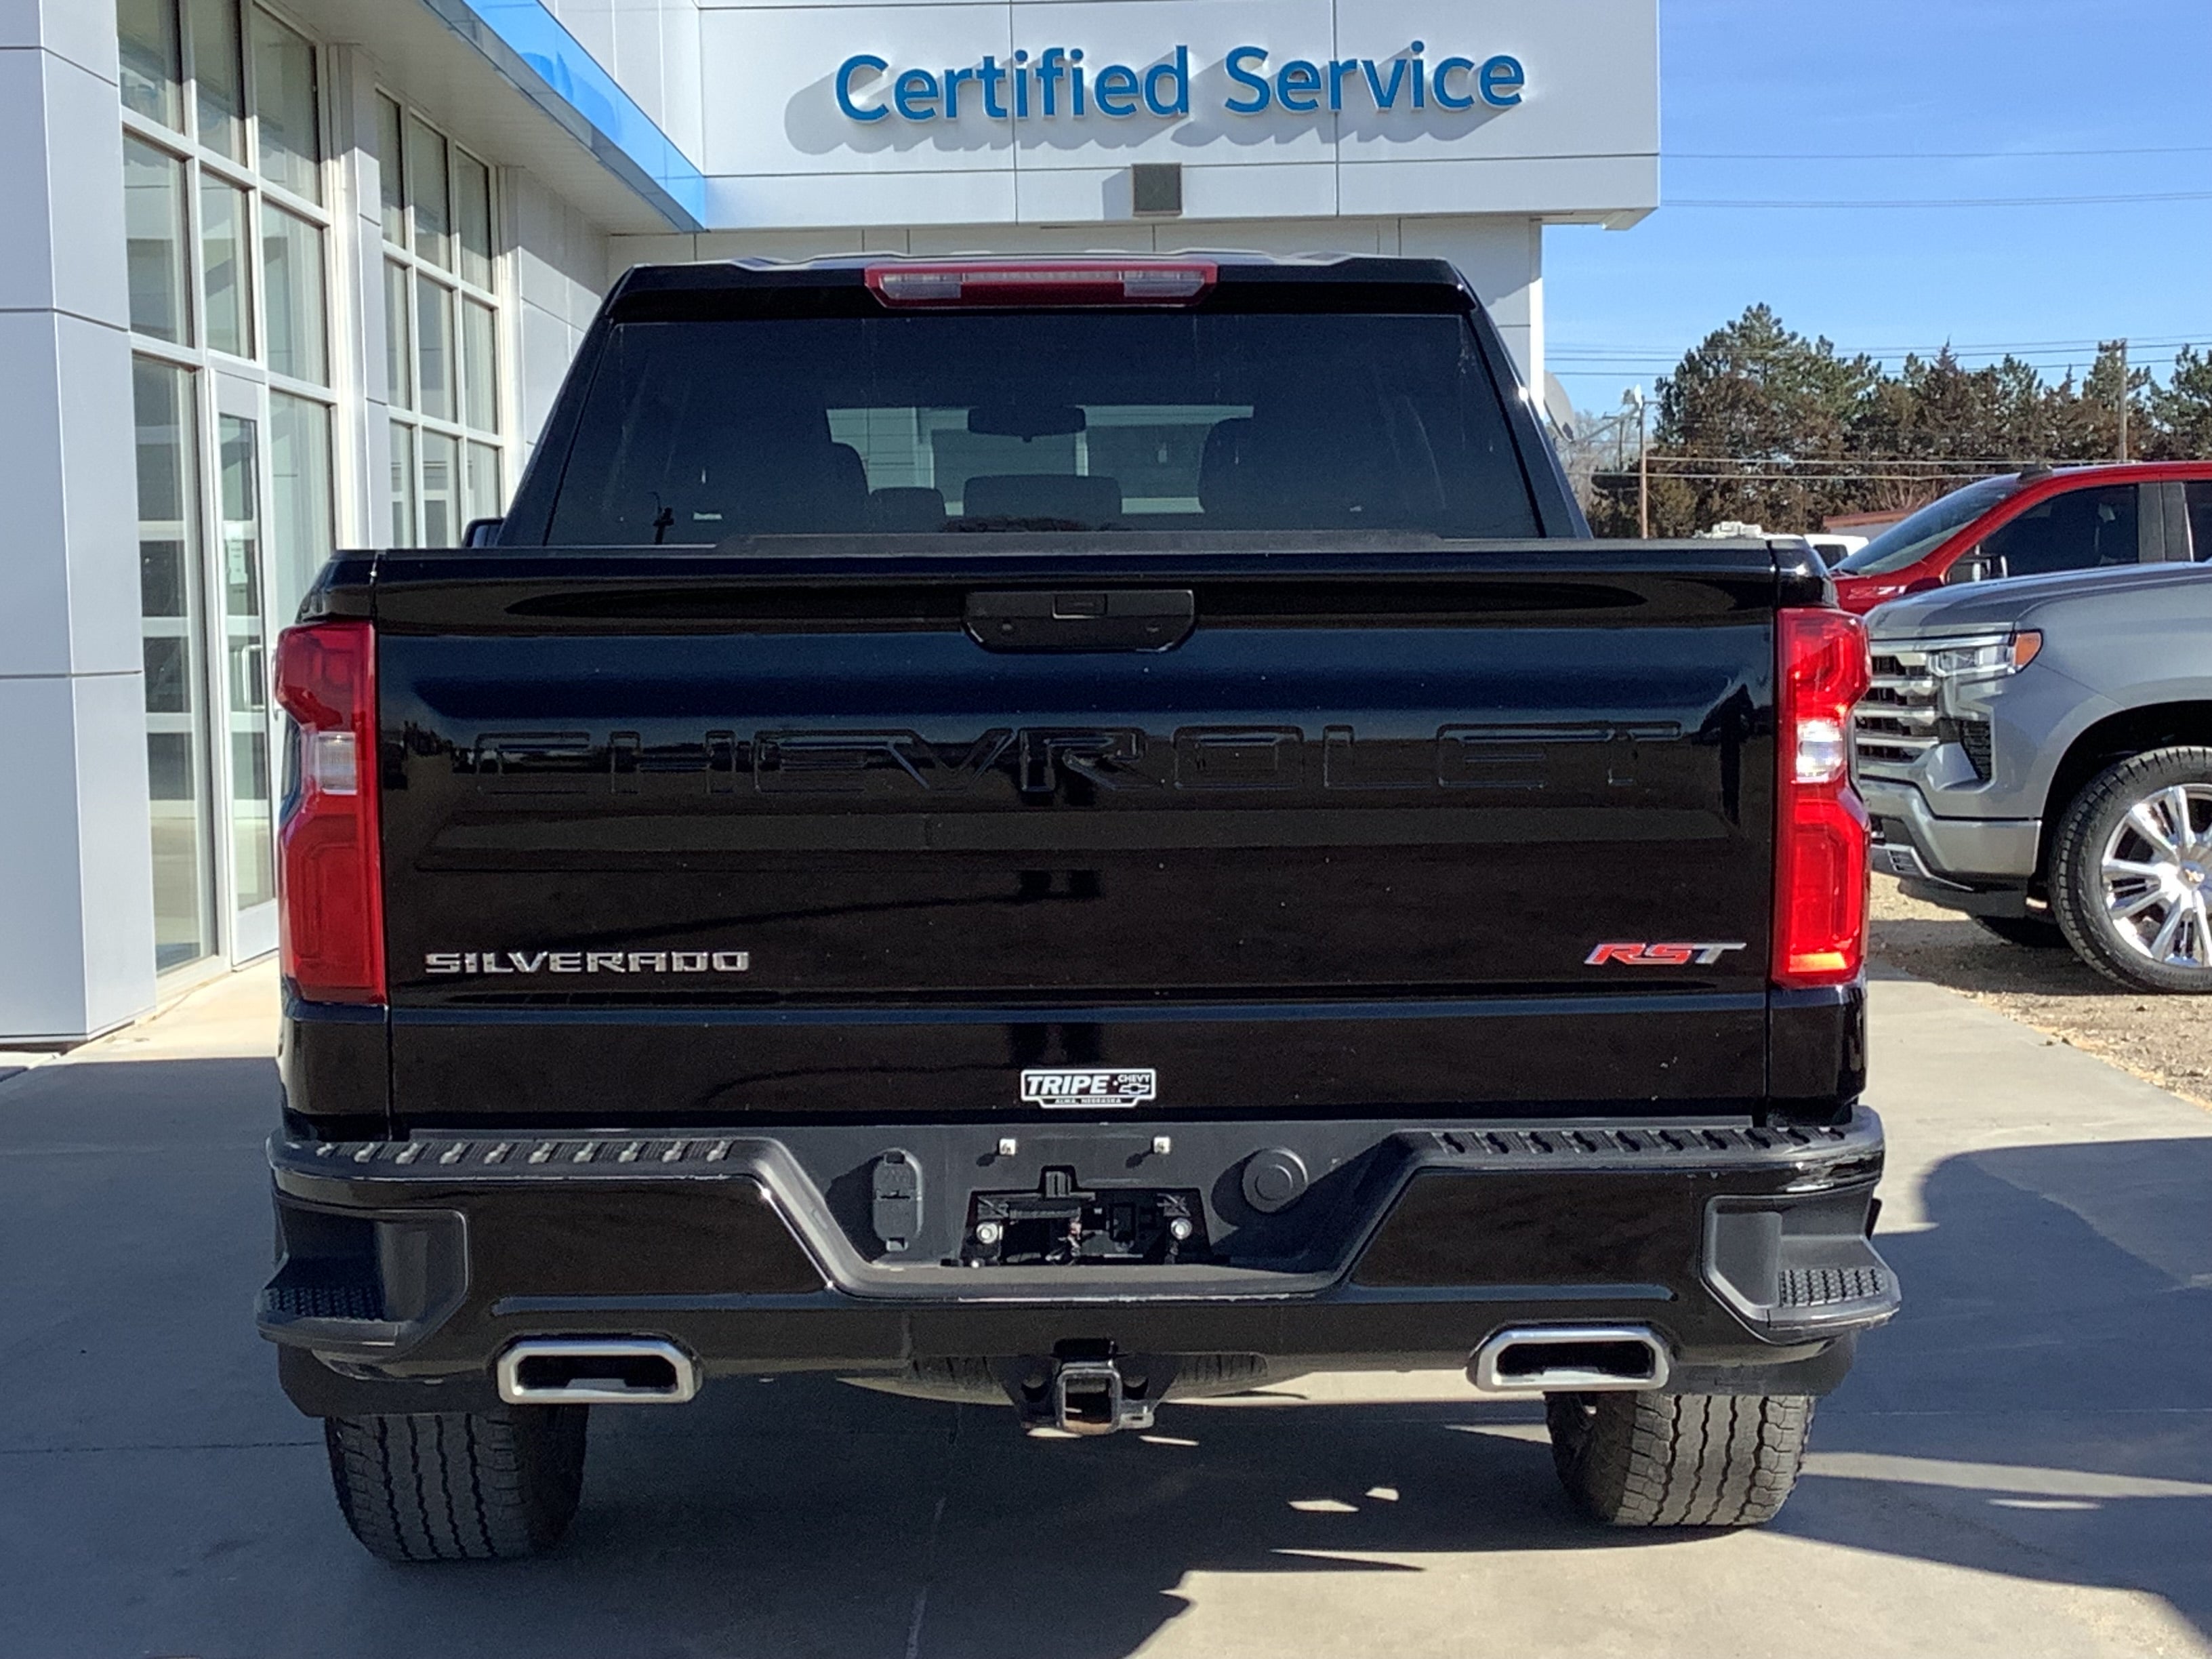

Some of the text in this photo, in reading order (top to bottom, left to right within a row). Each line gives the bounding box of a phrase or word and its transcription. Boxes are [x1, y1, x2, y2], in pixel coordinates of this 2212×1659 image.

[835, 41, 1525, 122] Certified Service
[476, 726, 1682, 792] CHEVROLET
[425, 952, 749, 972] SILVERADO
[1584, 943, 1746, 964] RST
[1027, 1074, 1150, 1094] TRIPE CHEVY
